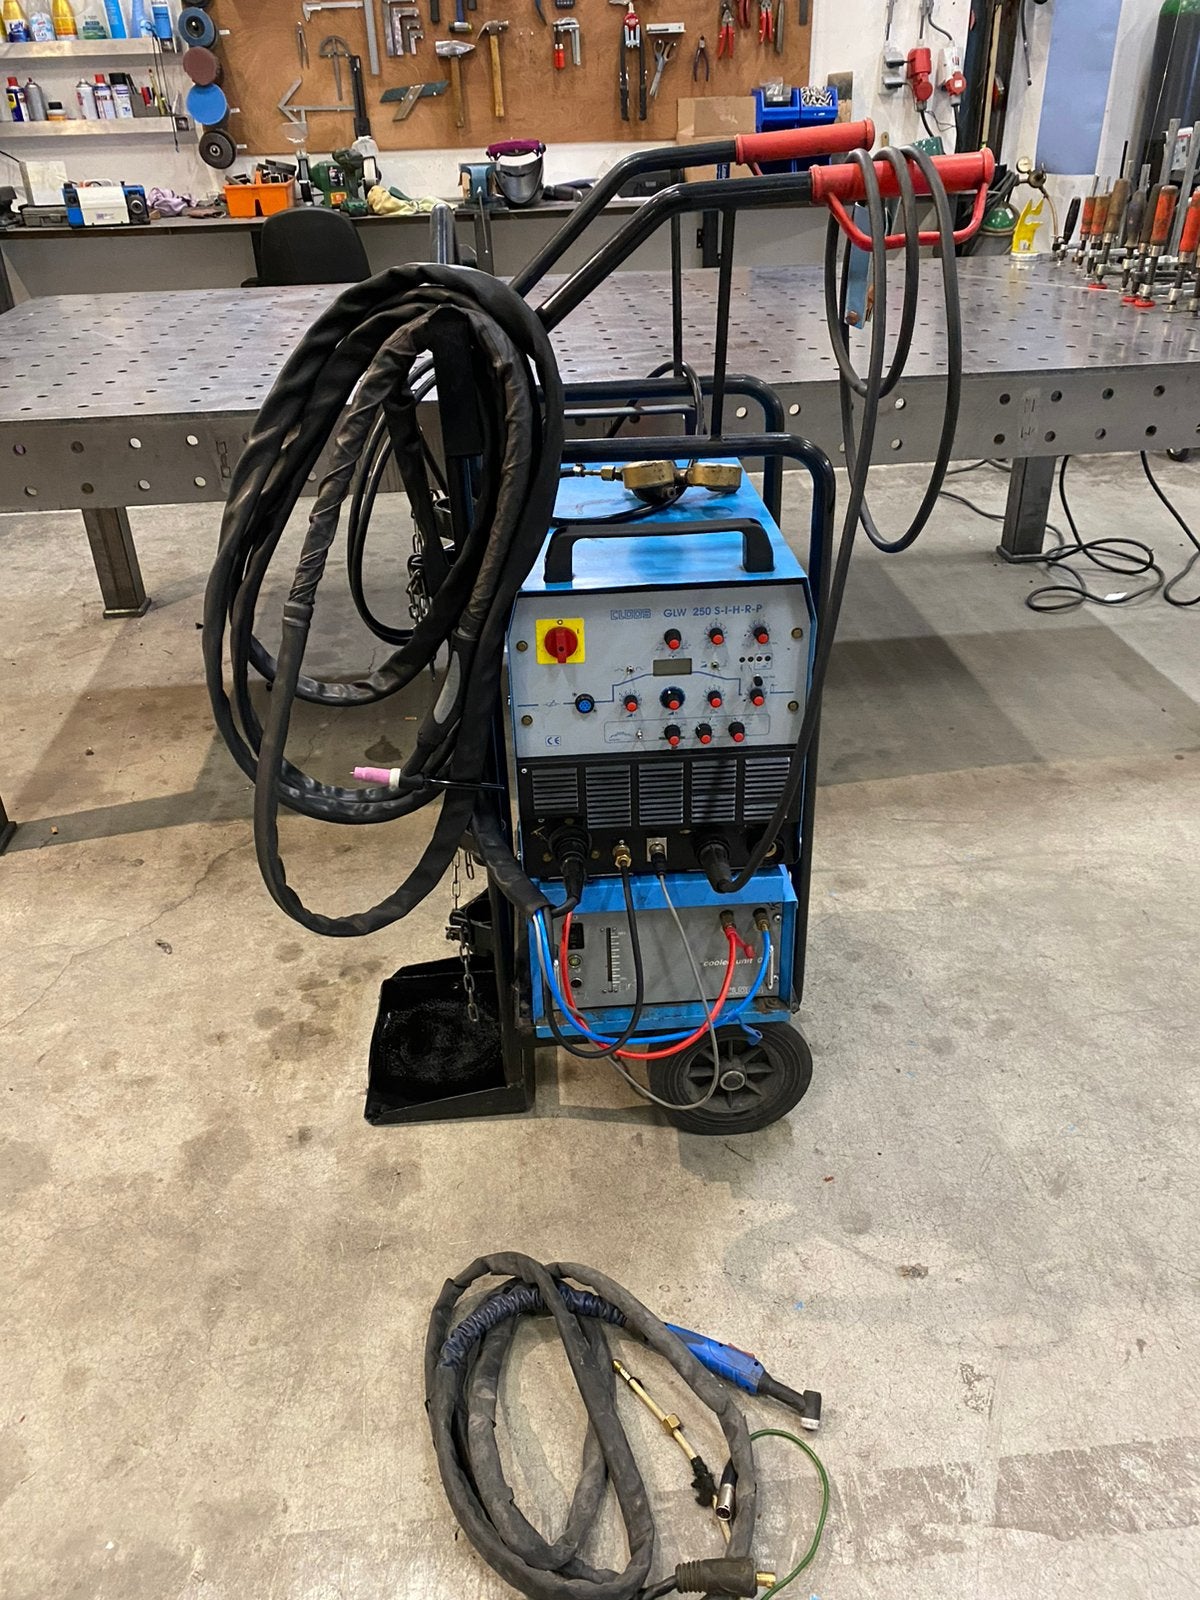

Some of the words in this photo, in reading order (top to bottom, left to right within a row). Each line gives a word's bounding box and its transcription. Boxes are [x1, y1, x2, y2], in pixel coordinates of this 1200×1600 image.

[663, 608, 687, 618] GLW
[692, 606, 712, 617] 250
[714, 603, 763, 616] S-I-H-R-P
[703, 958, 729, 967] coole
